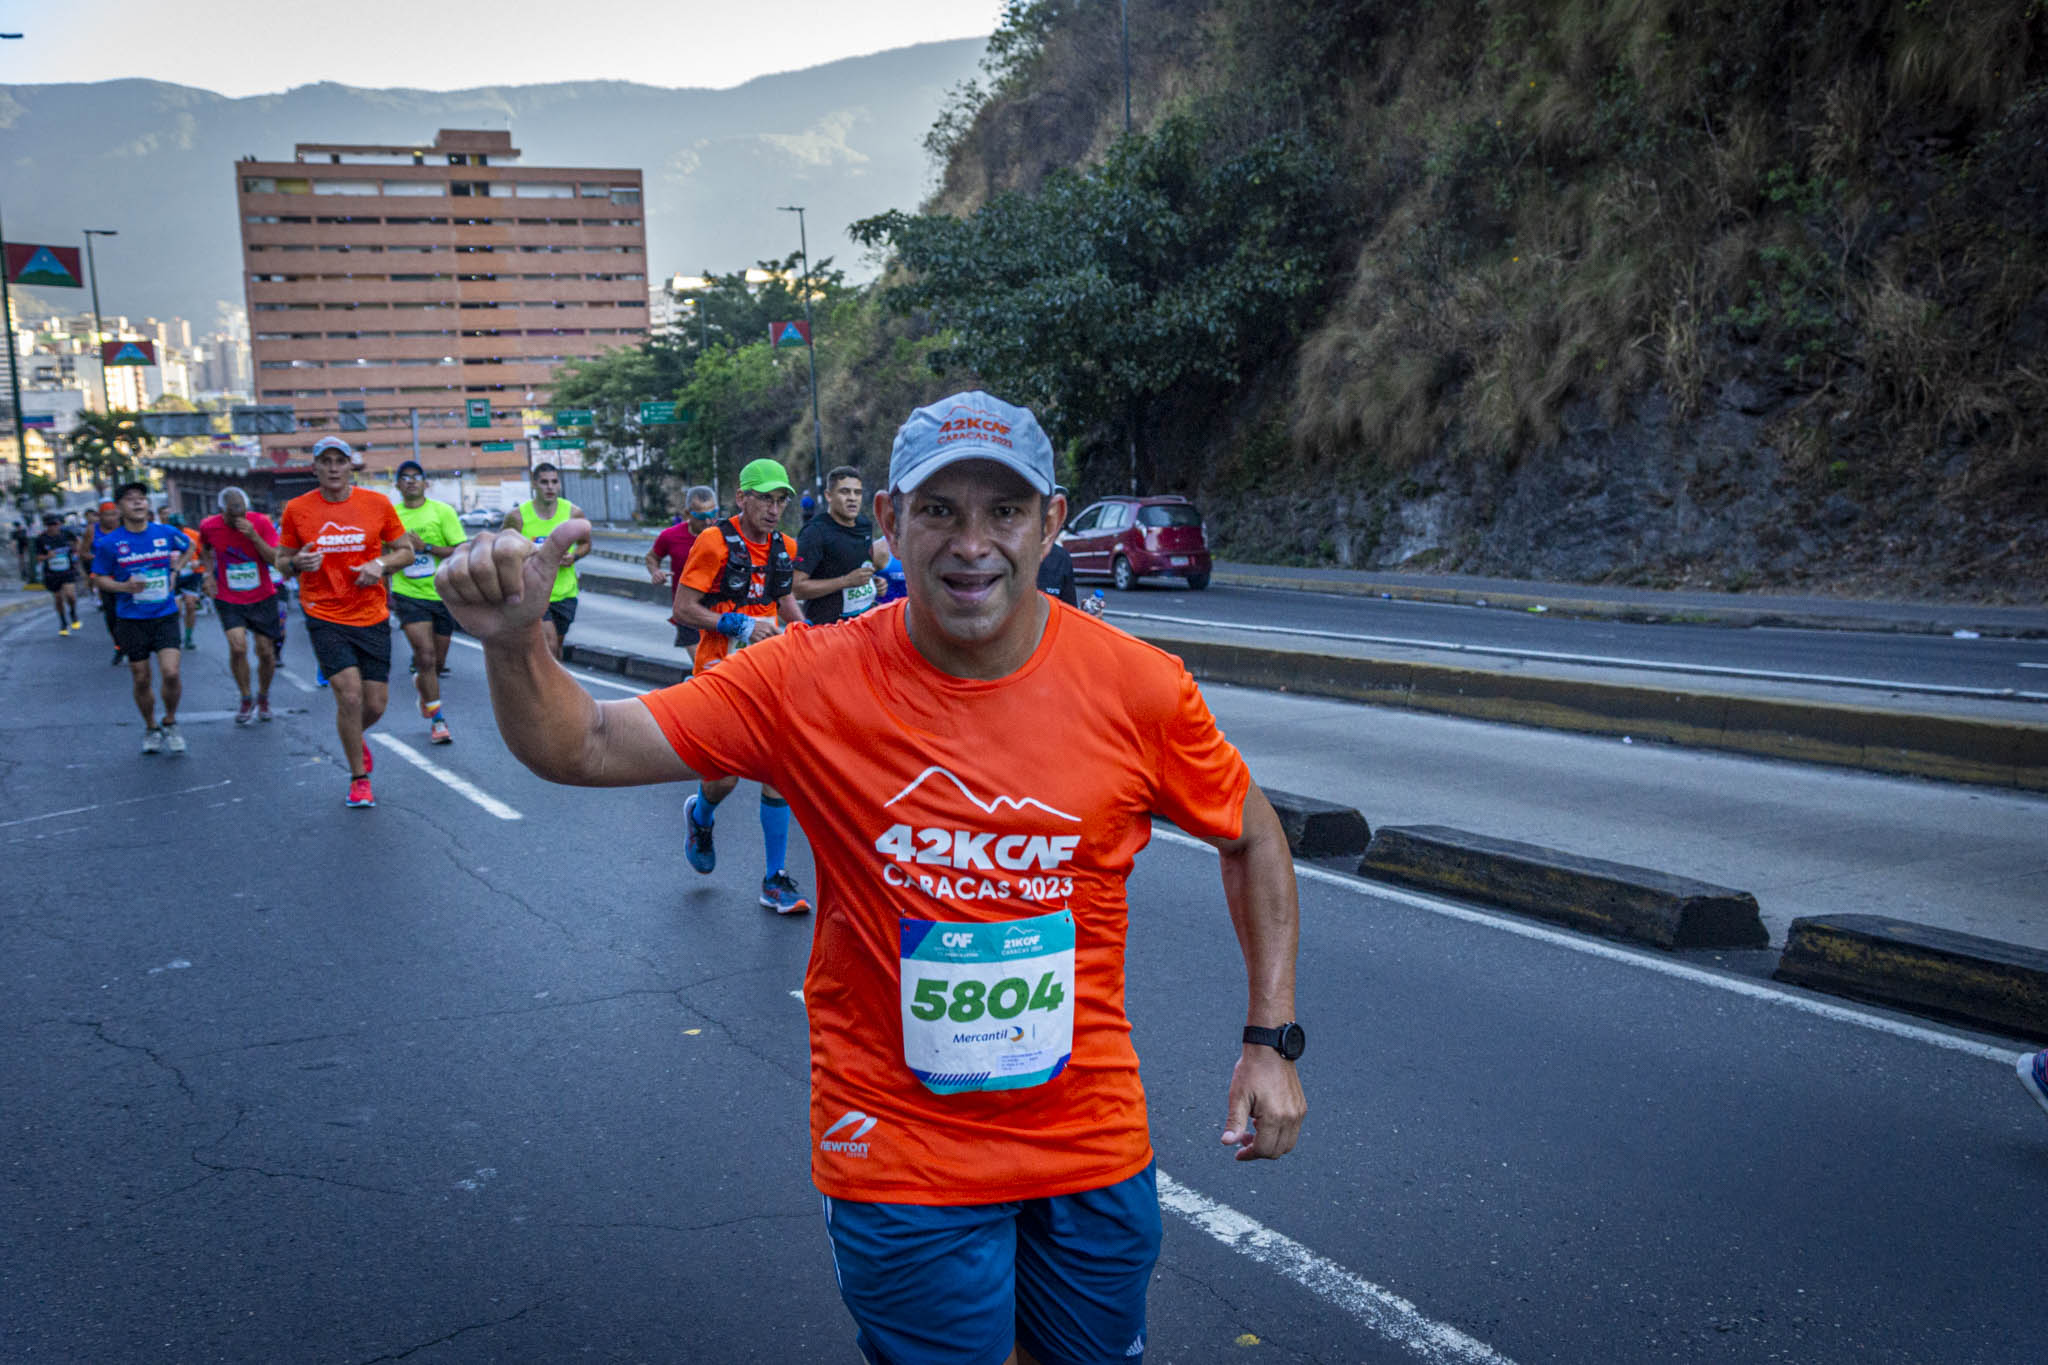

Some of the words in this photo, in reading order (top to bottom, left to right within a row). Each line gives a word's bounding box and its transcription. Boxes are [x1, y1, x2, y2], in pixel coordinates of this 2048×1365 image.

[937, 432, 989, 445] CARACAS
[882, 863, 1011, 901] CARACAS
[1018, 876, 1074, 901] 2023
[941, 932, 974, 949] CAF
[909, 970, 1065, 1024] 5804
[952, 1029, 1009, 1044] Mercantil
